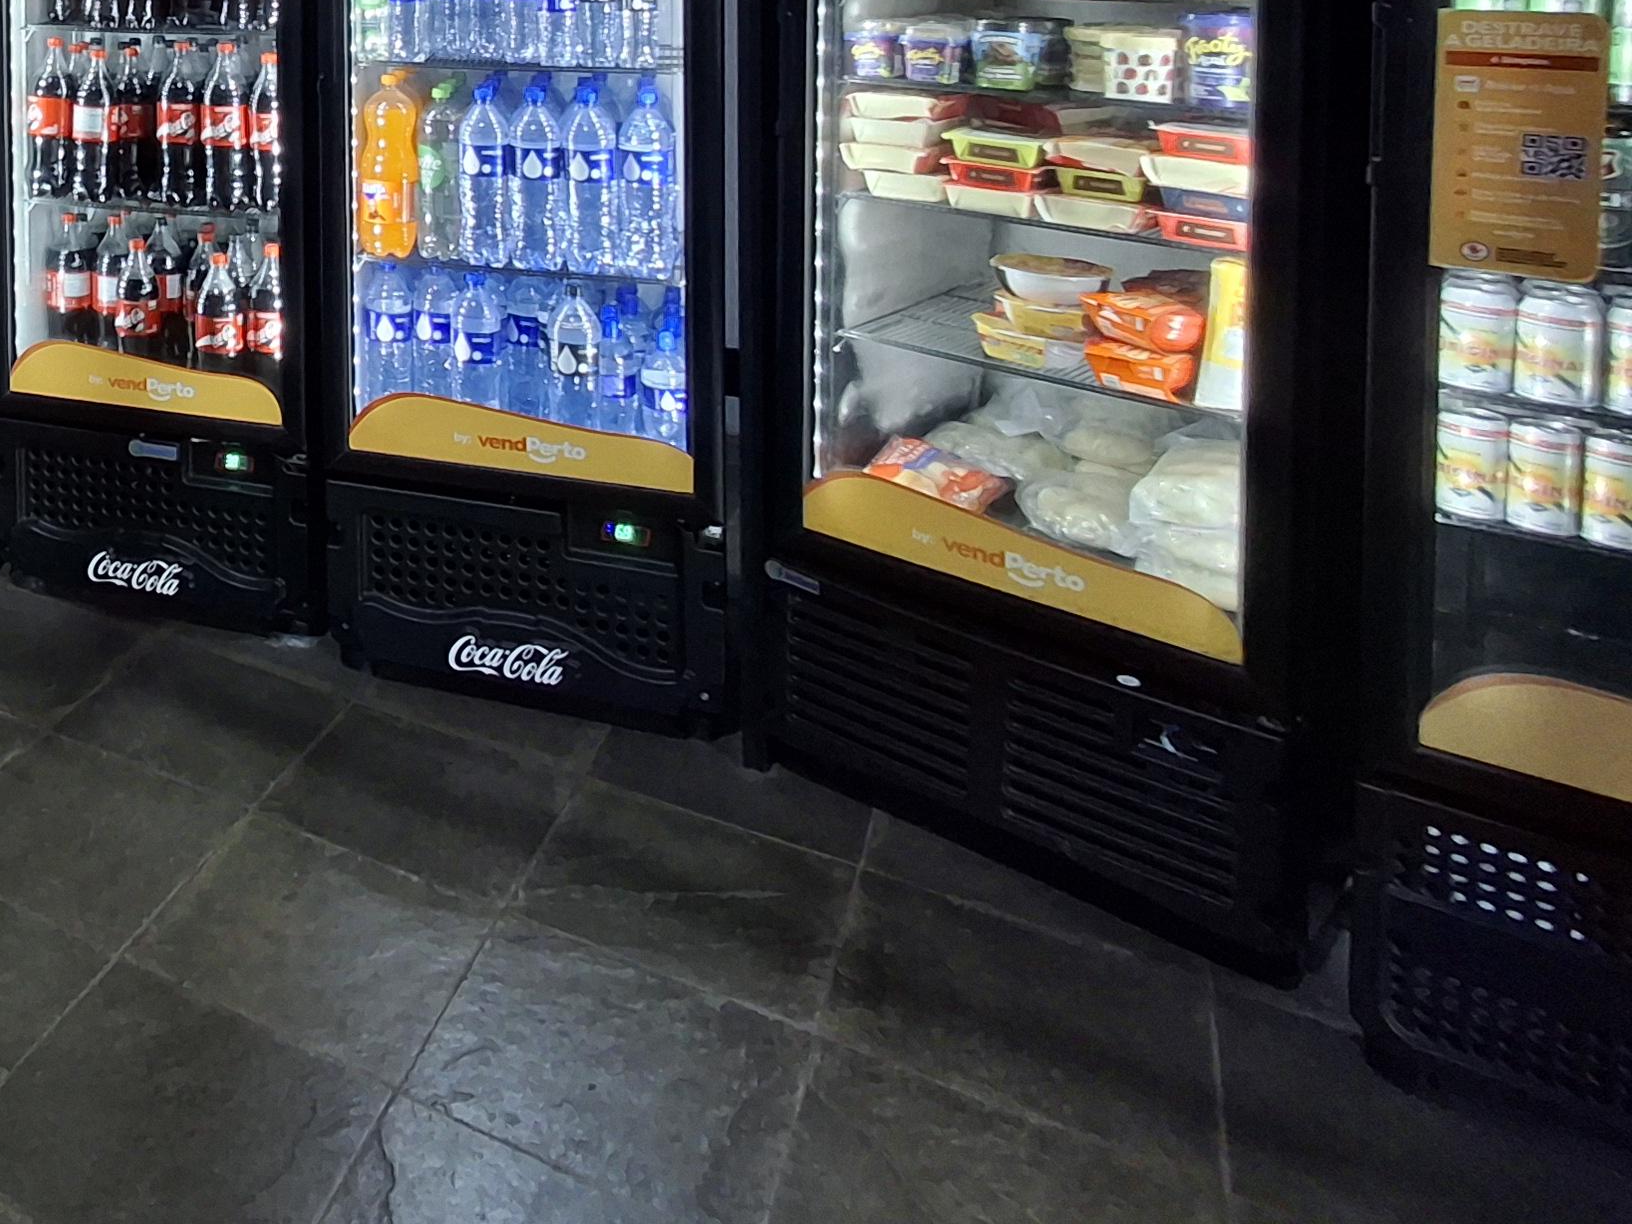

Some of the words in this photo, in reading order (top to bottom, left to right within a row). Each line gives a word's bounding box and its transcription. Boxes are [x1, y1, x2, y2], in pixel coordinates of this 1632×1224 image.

[108, 376, 195, 399] vendPerto
[478, 434, 586, 461] vendPerto
[87, 551, 184, 596] Coca-Cola
[942, 536, 1086, 592] vendPerto
[448, 635, 569, 685] Coca-Cola
